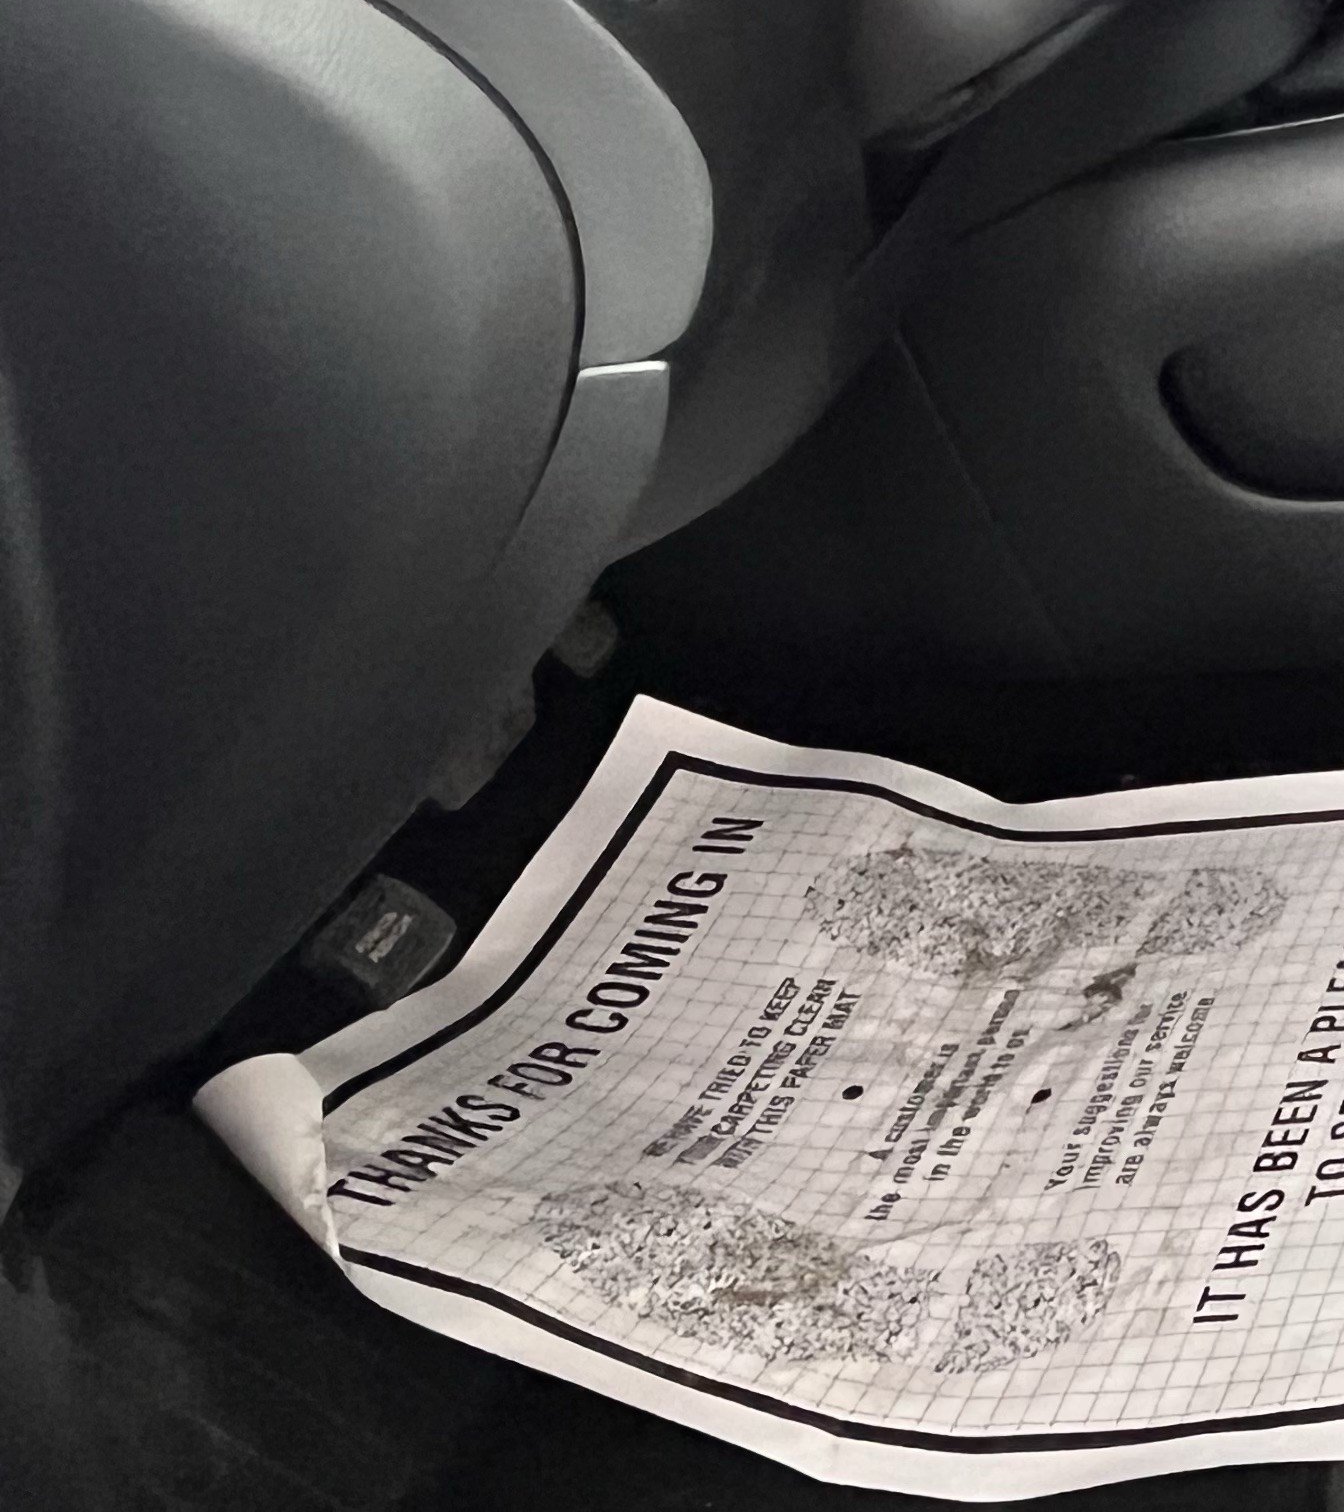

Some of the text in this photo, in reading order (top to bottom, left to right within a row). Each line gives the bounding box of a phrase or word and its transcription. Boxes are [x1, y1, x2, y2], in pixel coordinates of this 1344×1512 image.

[327, 1094, 521, 1206] THANKS
[488, 1042, 601, 1100] FOR
[566, 871, 727, 1034] COMING
[691, 817, 765, 855] IN
[697, 1055, 751, 1100] TRIED
[739, 1026, 772, 1049] TO
[759, 977, 801, 1021] KEEP
[1129, 1059, 1154, 1089] our
[1145, 991, 1188, 1053] service
[1297, 1044, 1342, 1065] A
[711, 978, 837, 1136] CARPETING CLEAN
[743, 1095, 795, 1138] THIS
[821, 987, 862, 1030] MAT
[936, 1126, 971, 1156] the
[1044, 1142, 1082, 1192] Your
[1116, 1154, 1145, 1186] are
[1134, 1078, 1178, 1149] always
[1252, 1079, 1329, 1173] BEEN
[864, 1191, 901, 1221] the
[894, 1138, 931, 1184] most
[923, 1163, 951, 1182] in
[1212, 1188, 1286, 1272] HAS
[1193, 1285, 1247, 1324] IT
